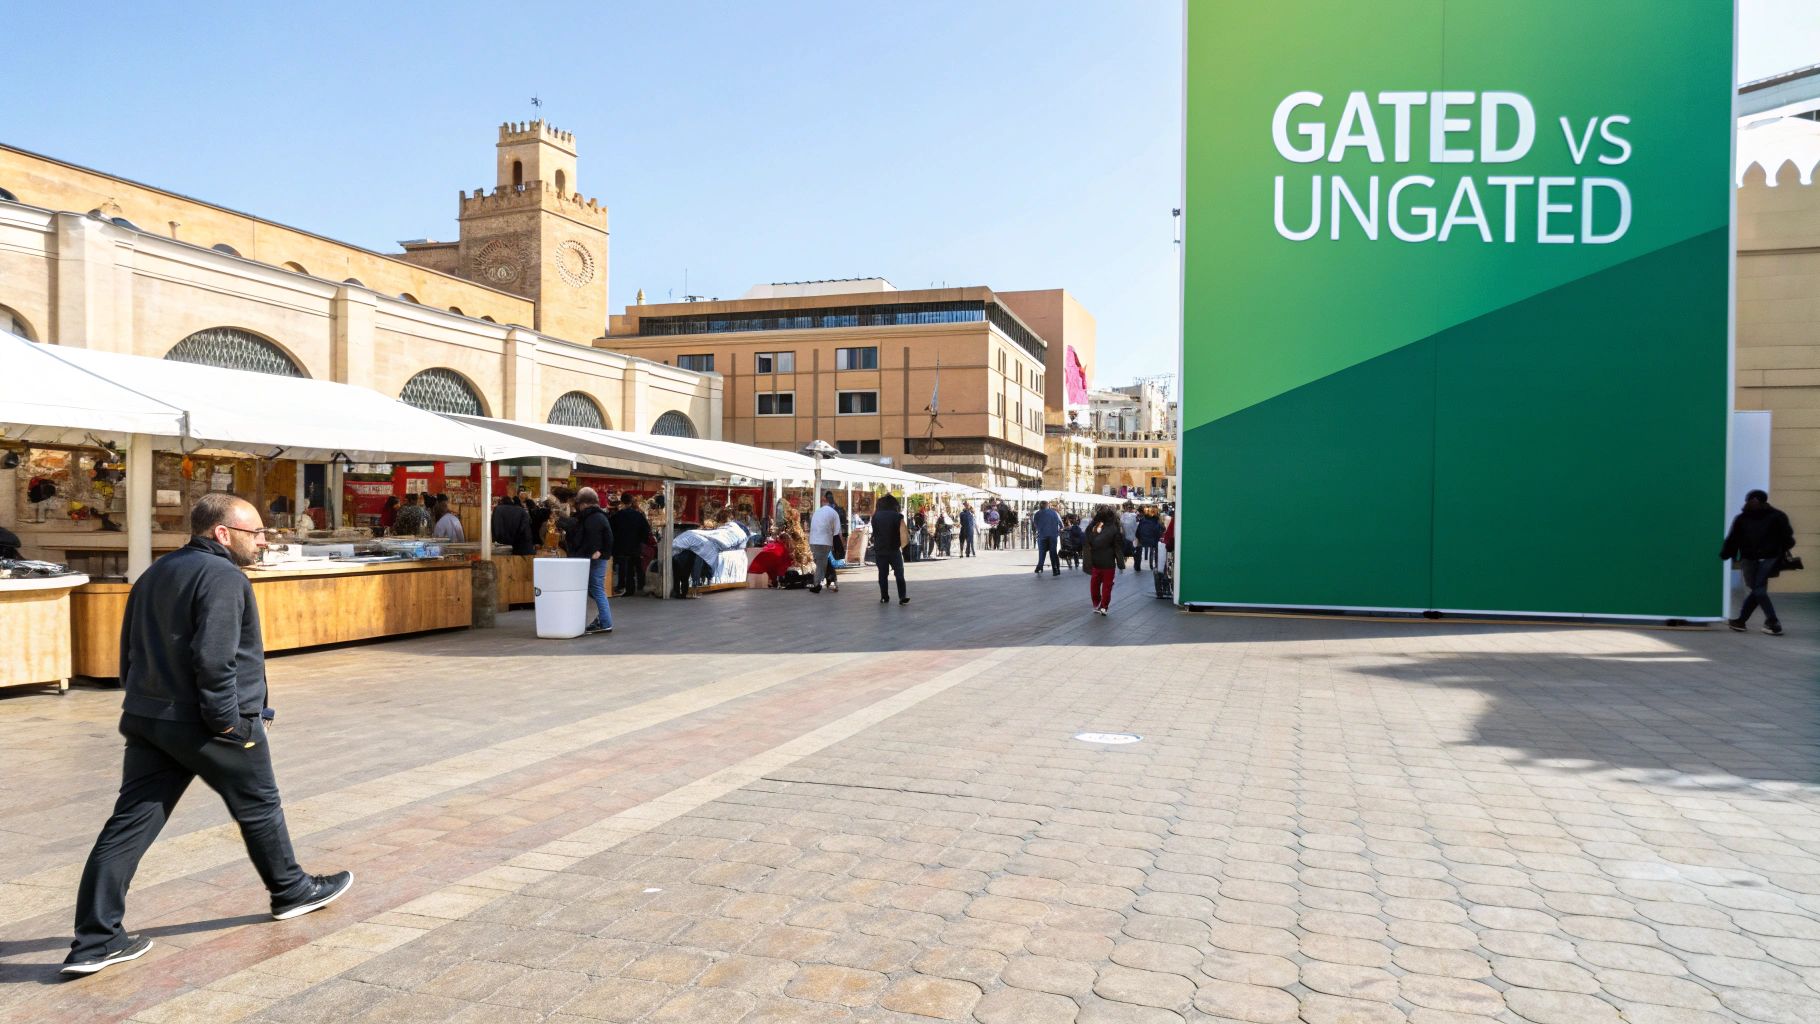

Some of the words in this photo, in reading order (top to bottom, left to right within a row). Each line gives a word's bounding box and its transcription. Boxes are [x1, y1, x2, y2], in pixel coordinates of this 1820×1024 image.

[1272, 91, 1536, 163] GATED
[1560, 115, 1632, 165] VS
[1273, 175, 1632, 244] UNGATED
